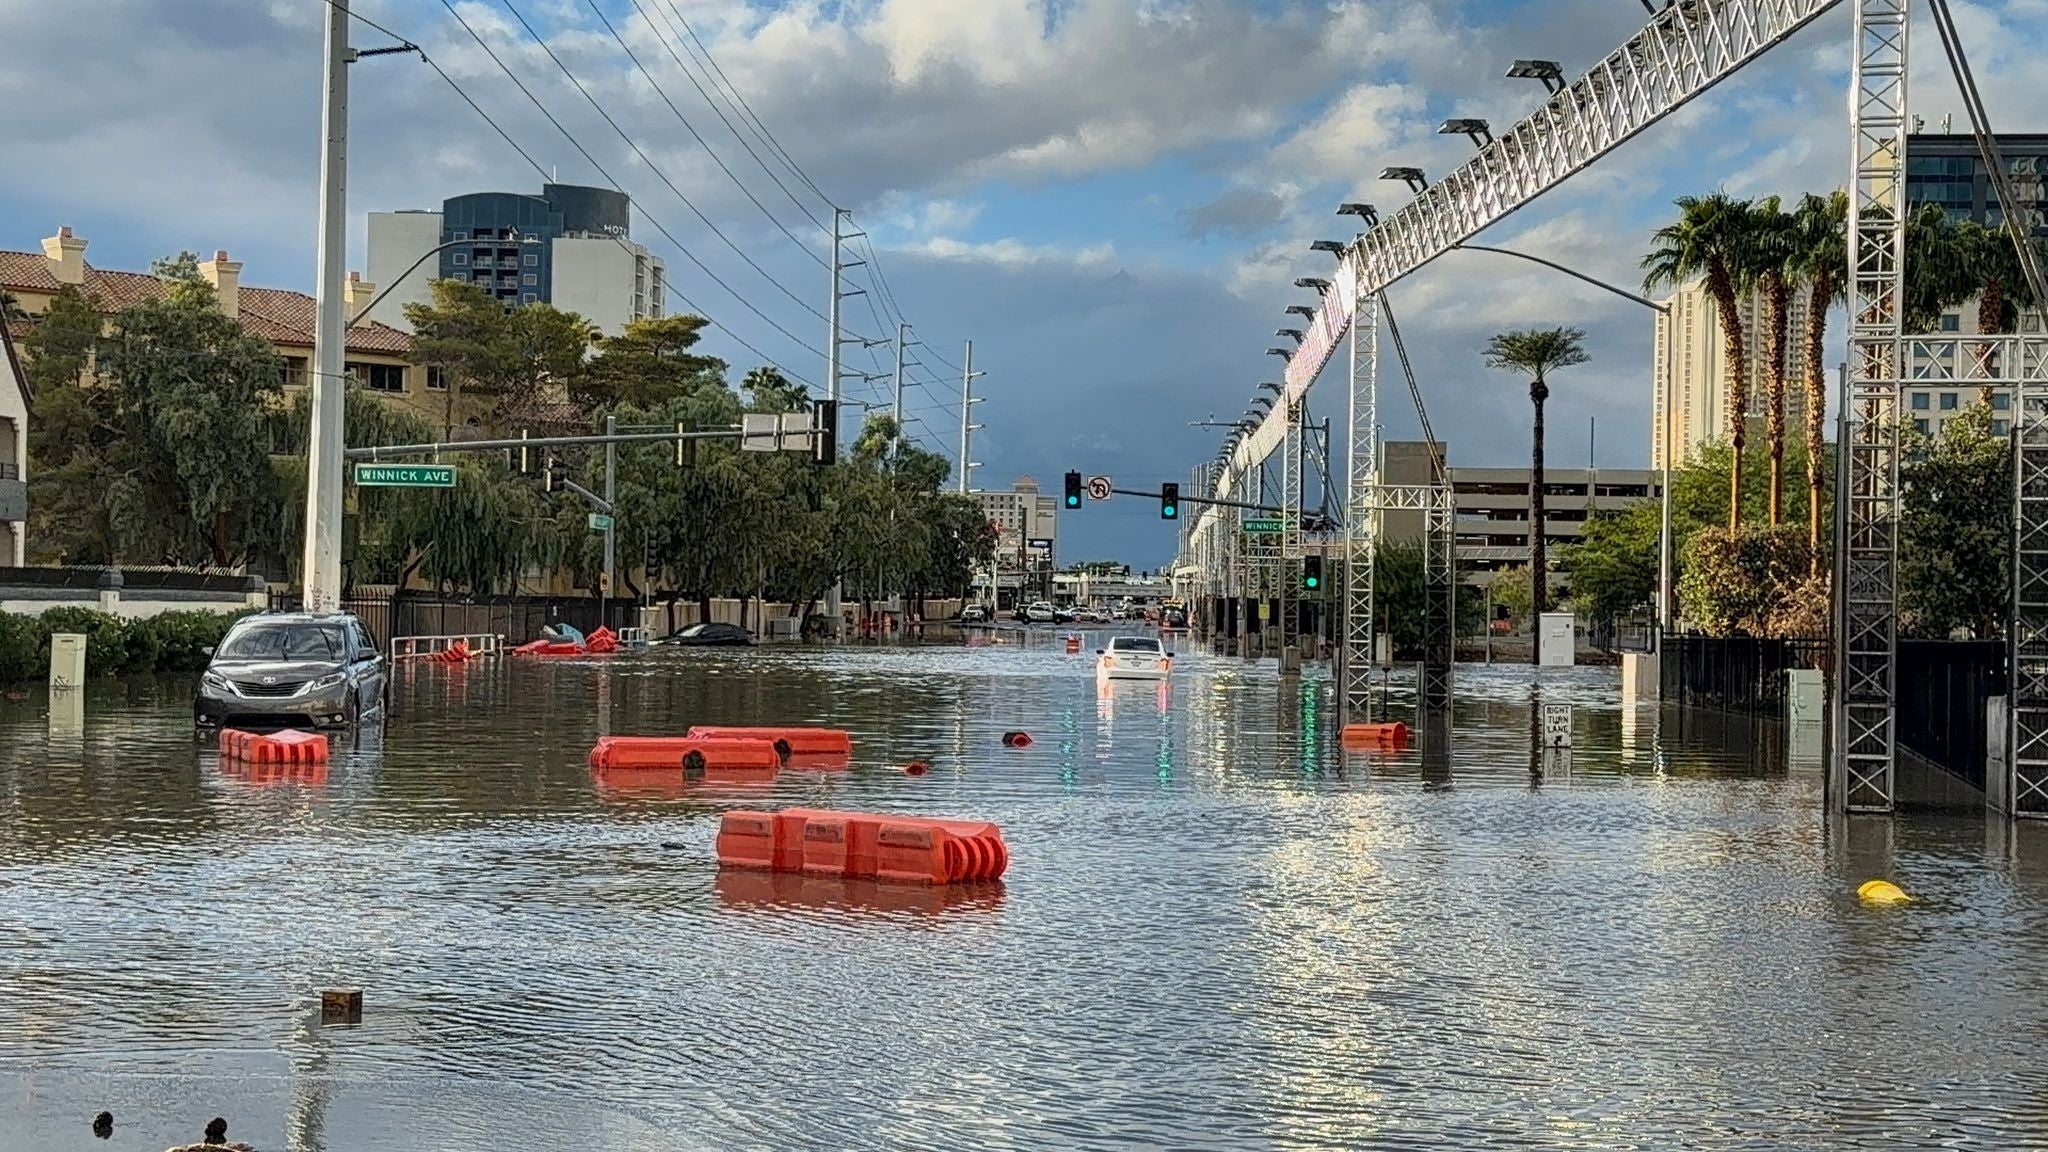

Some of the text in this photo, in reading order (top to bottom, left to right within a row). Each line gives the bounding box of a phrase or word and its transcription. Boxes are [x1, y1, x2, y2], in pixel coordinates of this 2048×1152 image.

[603, 224, 628, 236] HOT
[360, 469, 449, 482] WINNICK AVE
[1546, 706, 1569, 715] RIGHT
[1547, 715, 1569, 725] TURN
[1546, 724, 1569, 734] LANE
